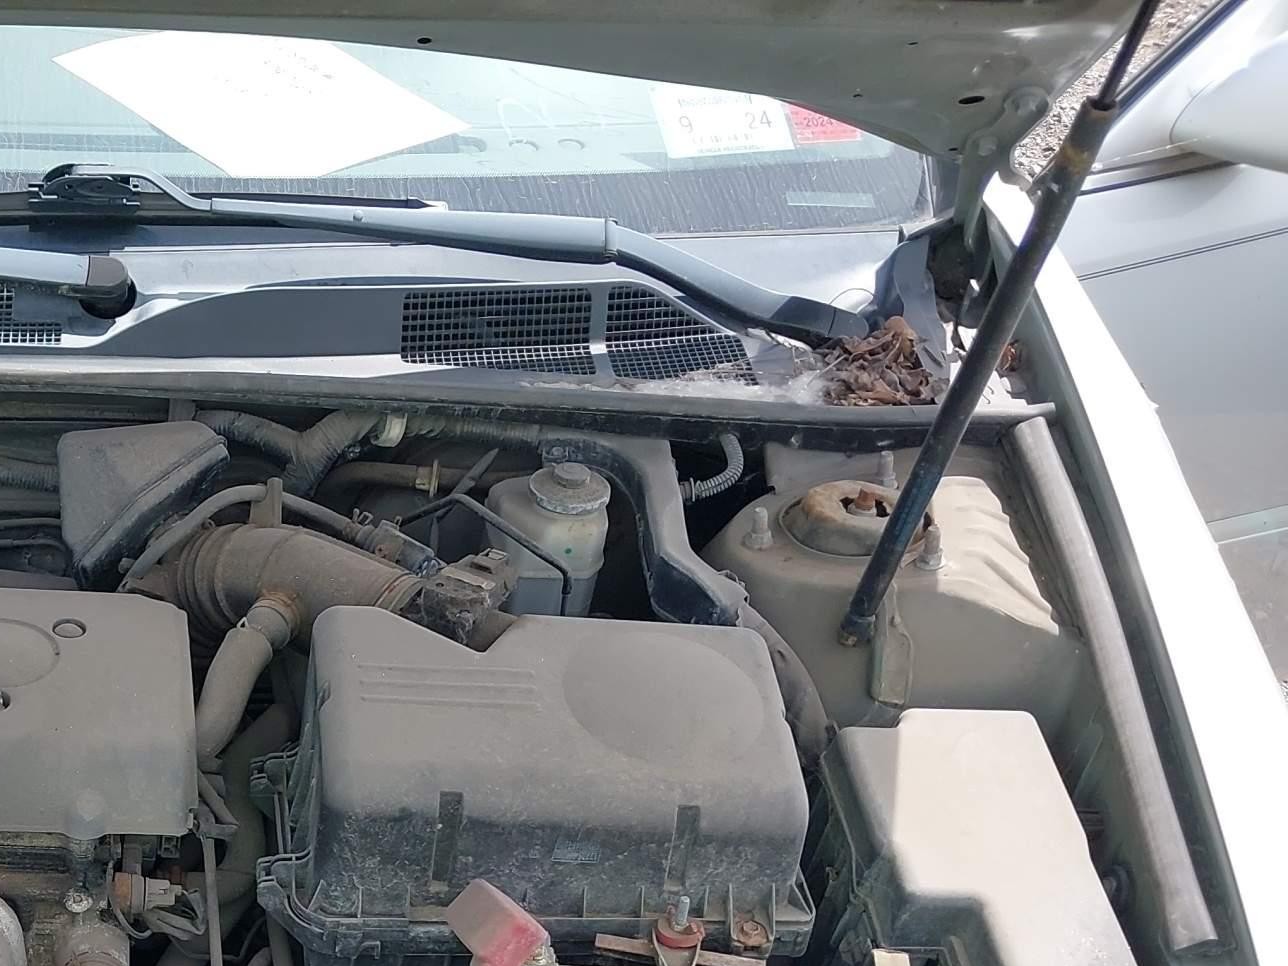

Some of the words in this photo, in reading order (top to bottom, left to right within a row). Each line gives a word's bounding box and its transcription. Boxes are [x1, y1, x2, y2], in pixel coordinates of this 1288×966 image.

[679, 115, 694, 134] 9
[745, 110, 772, 130] 24
[804, 116, 834, 128] 2024
